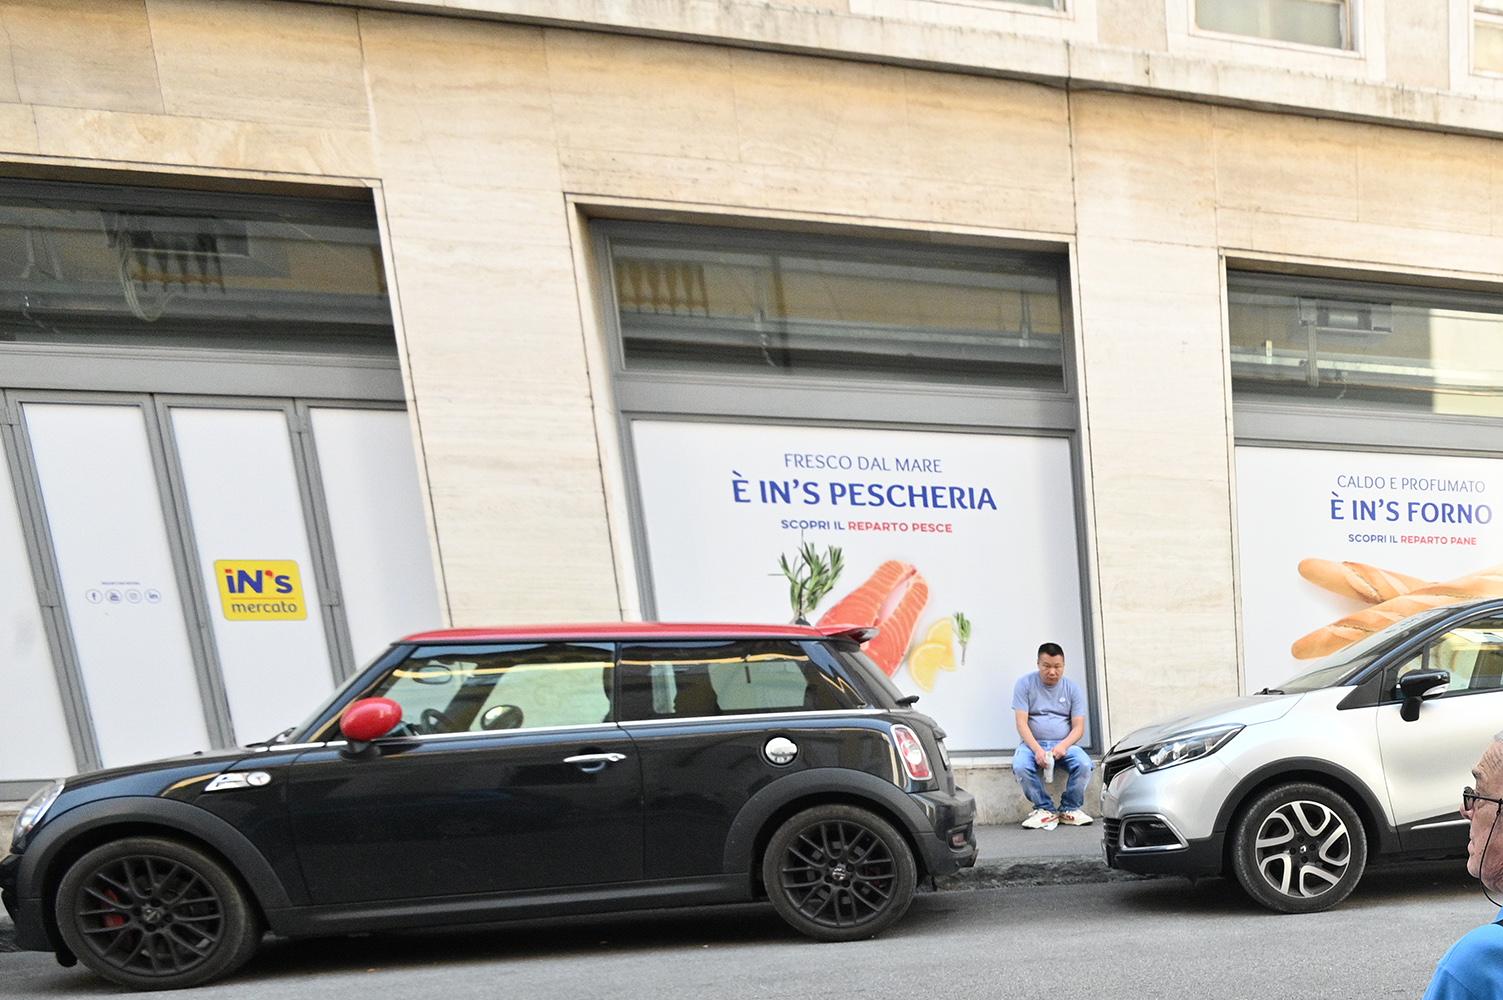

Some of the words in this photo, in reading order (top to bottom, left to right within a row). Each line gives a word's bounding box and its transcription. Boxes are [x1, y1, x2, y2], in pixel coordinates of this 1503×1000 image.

[784, 453, 852, 470] FRESCO
[857, 456, 891, 472] DAL
[895, 458, 943, 473] MARE
[732, 470, 751, 503] È
[829, 482, 997, 510] PESCHERIA
[1337, 474, 1386, 489] CALDO
[1390, 477, 1398, 489] E
[1402, 477, 1486, 493] PROFUMATO
[1330, 491, 1344, 520] È
[1407, 501, 1492, 524] FORNO
[781, 519, 830, 530] SCOPRI
[834, 521, 845, 531] IL
[848, 521, 908, 532] REPARTO
[912, 522, 953, 533] PESCE
[1348, 533, 1387, 543] SCOPRI
[1389, 535, 1398, 544] IL
[1400, 535, 1448, 545] REPARTO
[1450, 536, 1477, 546] PANE
[231, 601, 298, 613] mercato
